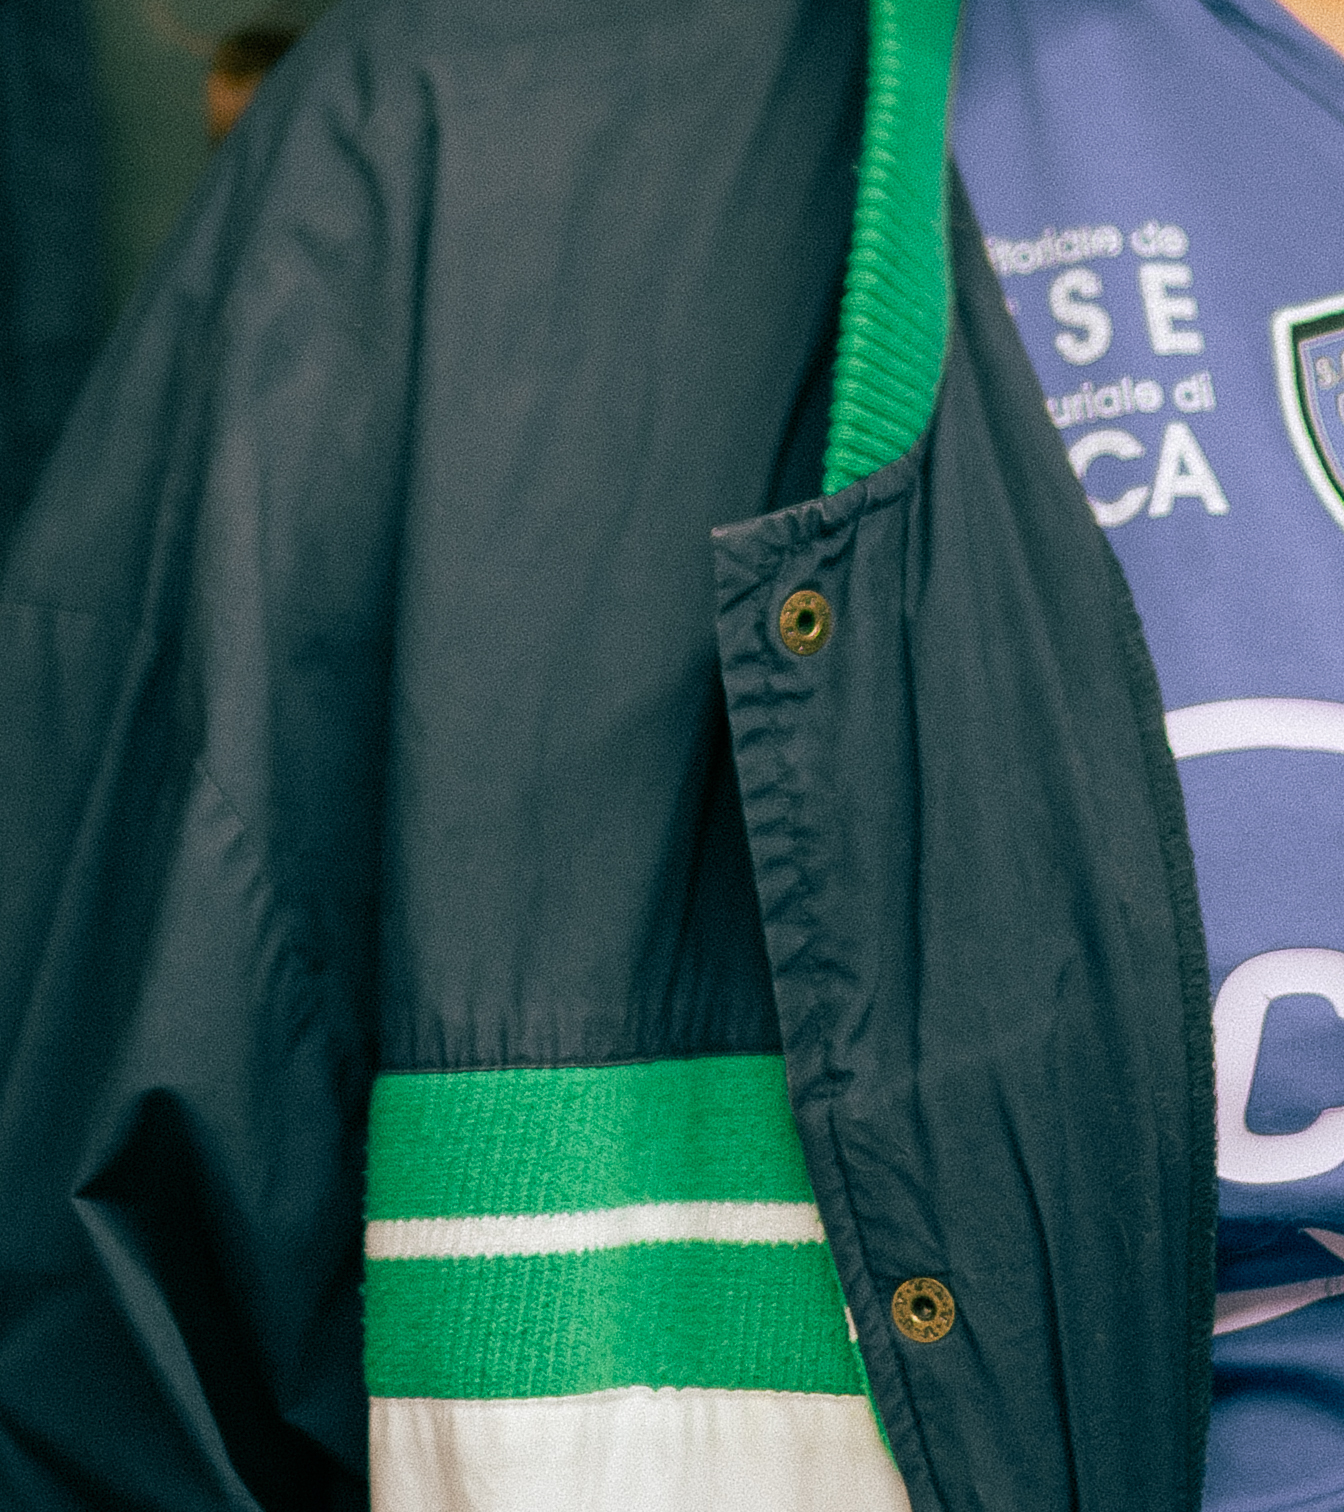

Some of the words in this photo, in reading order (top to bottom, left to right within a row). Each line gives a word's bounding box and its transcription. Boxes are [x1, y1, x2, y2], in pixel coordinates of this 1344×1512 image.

[1048, 262, 1206, 366] SE
[1045, 376, 1164, 429] uriale
[1172, 371, 1216, 413] di
[1067, 421, 1231, 528] CA
